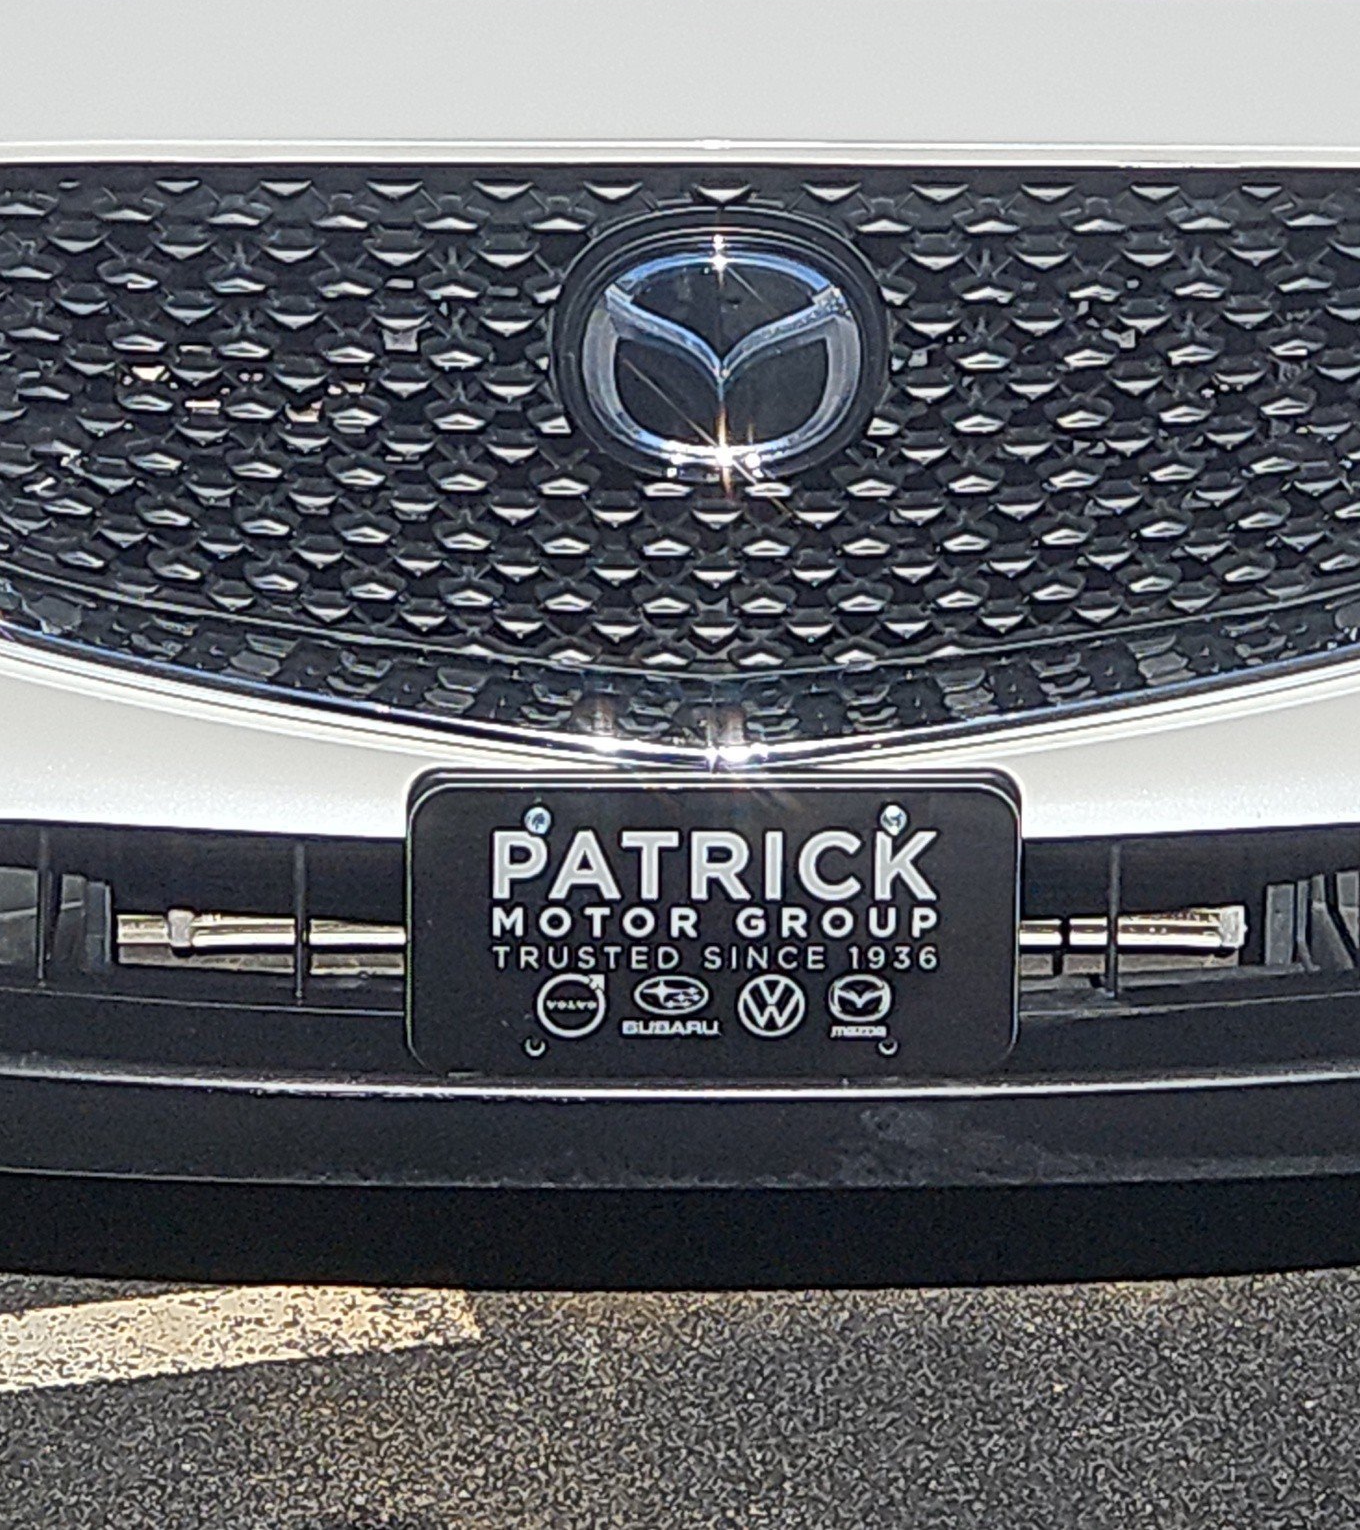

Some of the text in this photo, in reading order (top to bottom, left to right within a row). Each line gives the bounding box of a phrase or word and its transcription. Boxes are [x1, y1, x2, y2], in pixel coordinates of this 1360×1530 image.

[492, 830, 937, 901] PATRICK
[492, 906, 937, 938] MOTOR GROUP
[493, 946, 937, 969] TRUSTED SINCE 1936
[546, 999, 598, 1010] VOLVO
[622, 1020, 721, 1035] SUBARU
